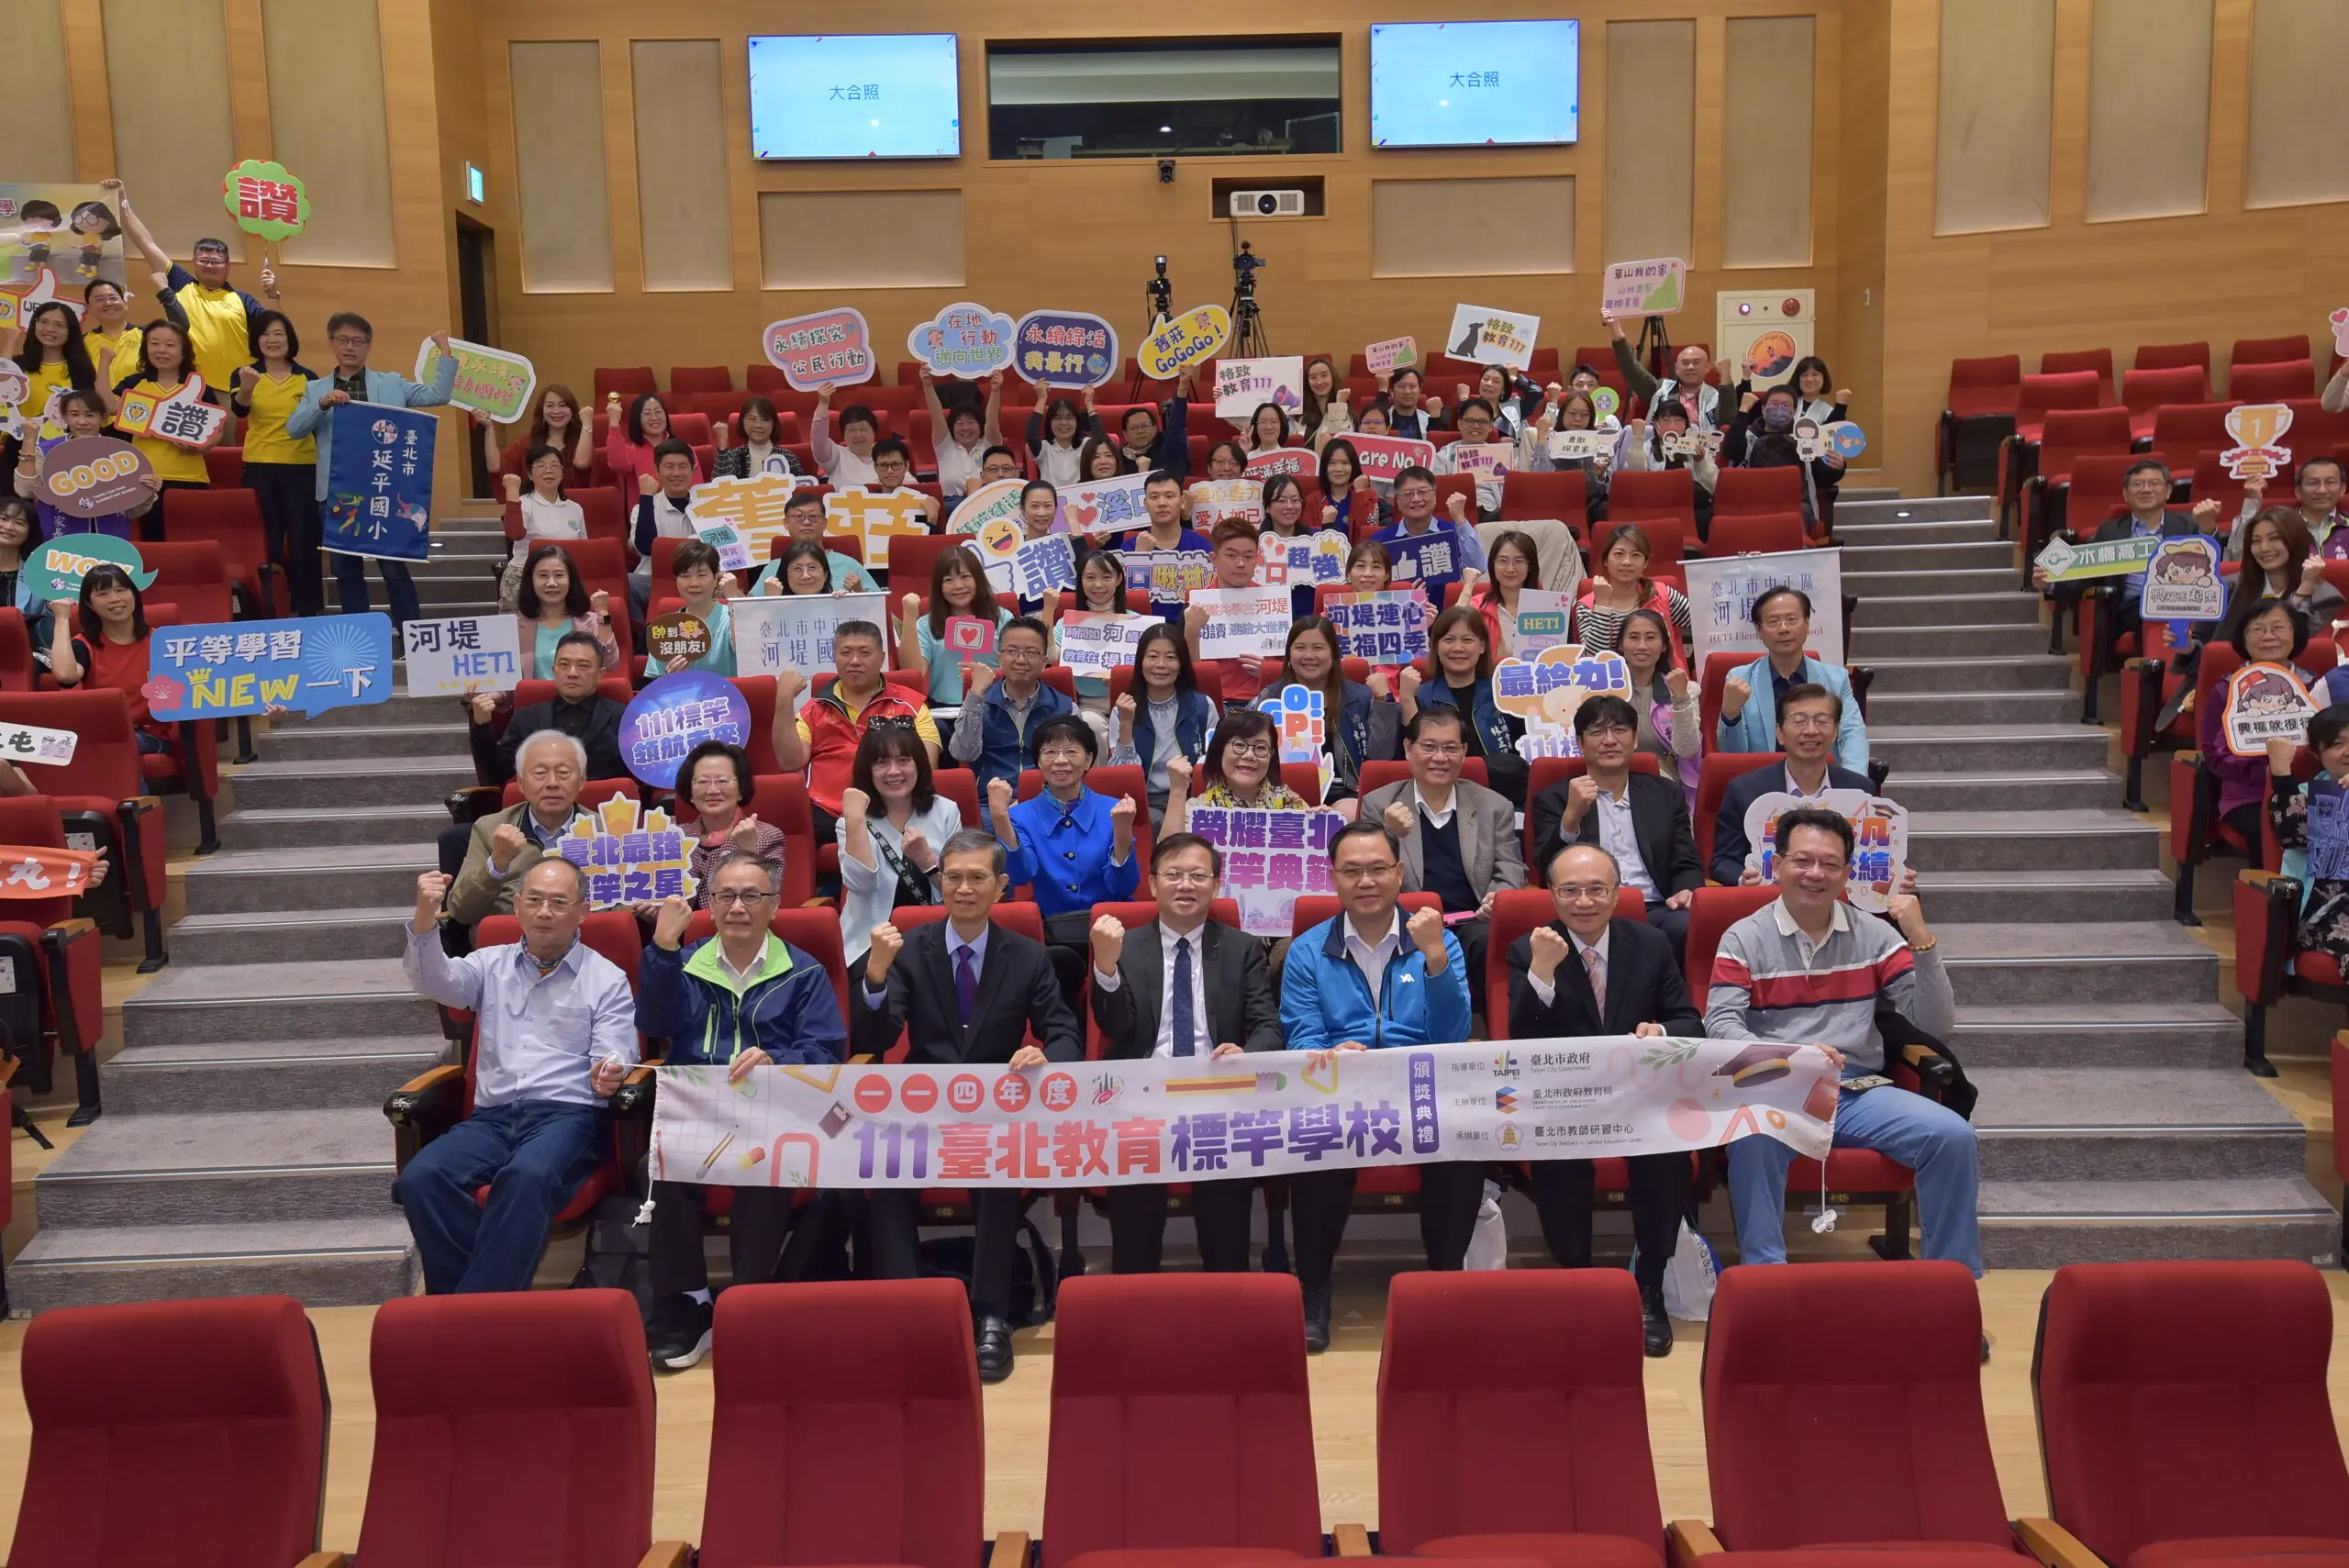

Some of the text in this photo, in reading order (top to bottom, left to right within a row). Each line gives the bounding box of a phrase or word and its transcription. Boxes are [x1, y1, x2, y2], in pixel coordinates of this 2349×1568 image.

[829, 83, 880, 102] 大合照
[1450, 71, 1500, 89] 大合照
[238, 176, 302, 226] 讚
[1613, 262, 1668, 280] 草山我的家
[948, 313, 983, 329] 在地
[774, 324, 847, 353] 永續探究
[961, 329, 998, 346] 行動
[1026, 324, 1107, 349] 永續綠活
[1153, 325, 1186, 353] 舊莊
[793, 348, 865, 374] 公民行動
[936, 347, 1002, 366] 邁向世界
[1023, 350, 1085, 373] 我最行
[161, 401, 210, 441] 讚
[2252, 417, 2262, 439] 1
[402, 429, 418, 476] 臺北市
[49, 450, 139, 496] GOOD
[368, 450, 394, 540] 延平國小
[1286, 546, 1343, 583] 超強
[1419, 540, 1453, 577] 讚
[2078, 540, 2155, 565] 木柵高工
[1018, 539, 1076, 596] 讚
[759, 617, 863, 639] 臺北市中正
[1327, 602, 1423, 628] 河堤連心
[407, 619, 482, 654] 河堤
[652, 625, 679, 640] 帥到
[163, 629, 304, 668] 平等學習
[660, 640, 706, 656] 沒朋友!
[189, 666, 376, 709] NEW 一下
[635, 696, 730, 740] 111標竿
[1192, 808, 1346, 850] 榮耀臺北
[561, 831, 683, 868] 臺北最強
[1218, 851, 1340, 892] 竿典範
[1452, 1062, 1486, 1072] 指導單位
[1531, 1051, 1591, 1066] 臺北市政府
[1493, 1069, 1520, 1077] TAIPEI
[858, 1075, 1074, 1110] 一一四年度
[1412, 1059, 1436, 1146] 頒獎典禮
[1453, 1096, 1486, 1106] 主辦單位
[1532, 1085, 1613, 1099] 臺北市政府教育局
[852, 1101, 1404, 1180] 111臺北教育標竿學校
[1456, 1130, 1489, 1141] 承辦單位
[1534, 1123, 1634, 1138] 臺北市教師研習中心
